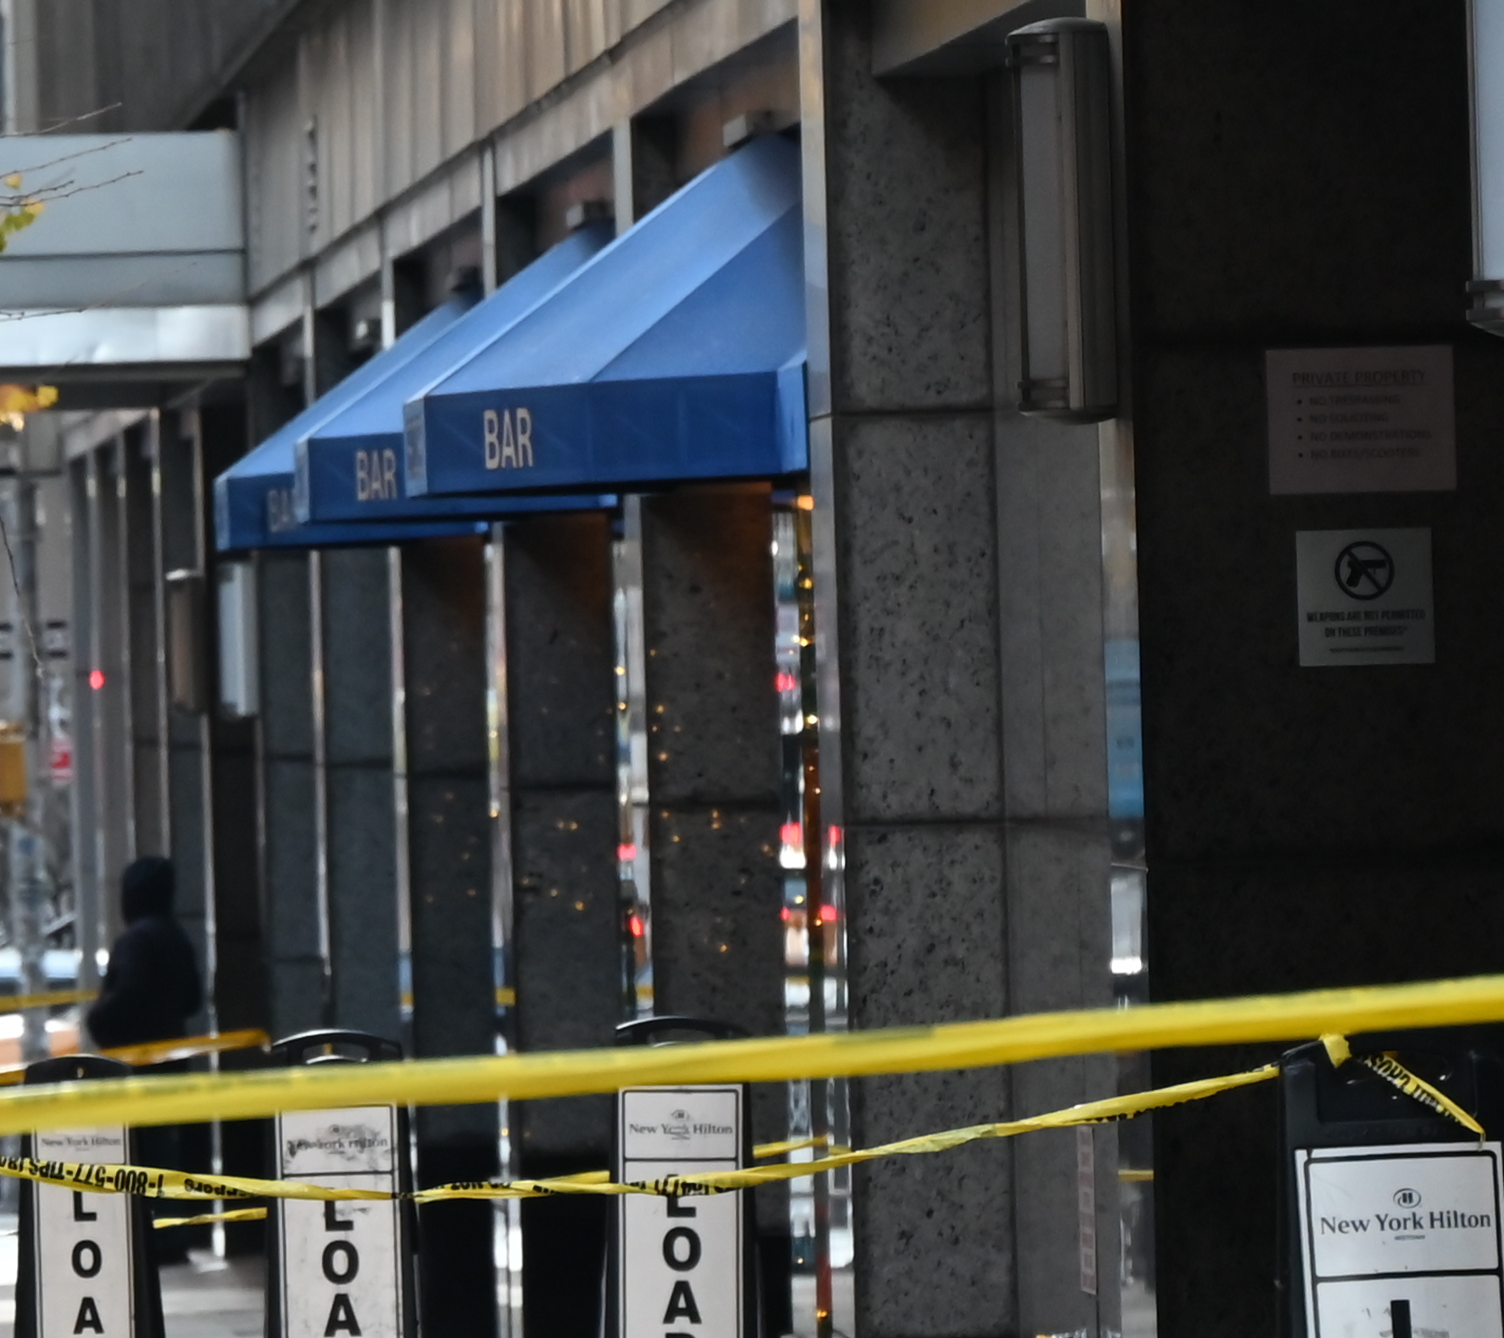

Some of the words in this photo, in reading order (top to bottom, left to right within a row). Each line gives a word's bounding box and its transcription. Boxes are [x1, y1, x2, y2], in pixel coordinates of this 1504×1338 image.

[1293, 371, 1352, 386] PRIVATE
[1355, 369, 1425, 385] PROPERTY
[482, 407, 534, 471] BAR
[355, 449, 397, 502] BAR
[1306, 610, 1345, 622] WEAPONS
[1347, 610, 1362, 621] ARE
[1364, 609, 1378, 621] NOT
[1324, 626, 1337, 638] ON
[1338, 625, 1362, 637] THESE
[630, 1123, 658, 1134] New
[693, 1123, 733, 1134] Hilton
[1320, 1217, 1370, 1235] New
[1375, 1212, 1424, 1232] York
[1429, 1210, 1491, 1230] Hilton
